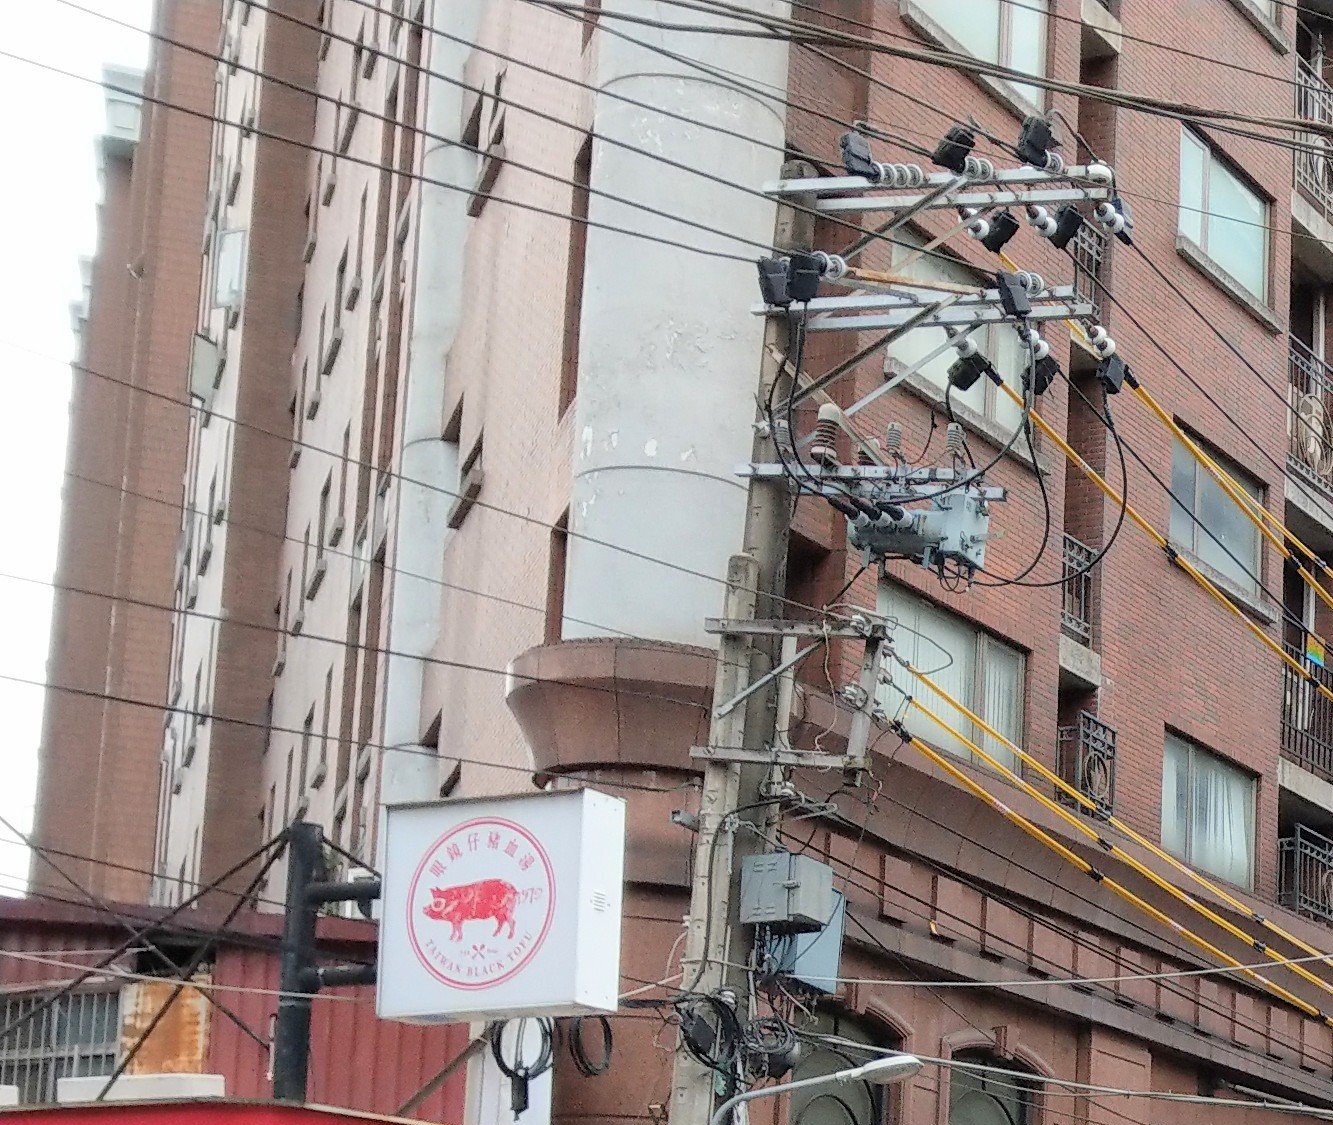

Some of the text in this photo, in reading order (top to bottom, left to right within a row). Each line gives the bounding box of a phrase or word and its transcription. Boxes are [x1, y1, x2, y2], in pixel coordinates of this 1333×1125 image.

[425, 931, 533, 977] TAIWAN BLACK TOFU
